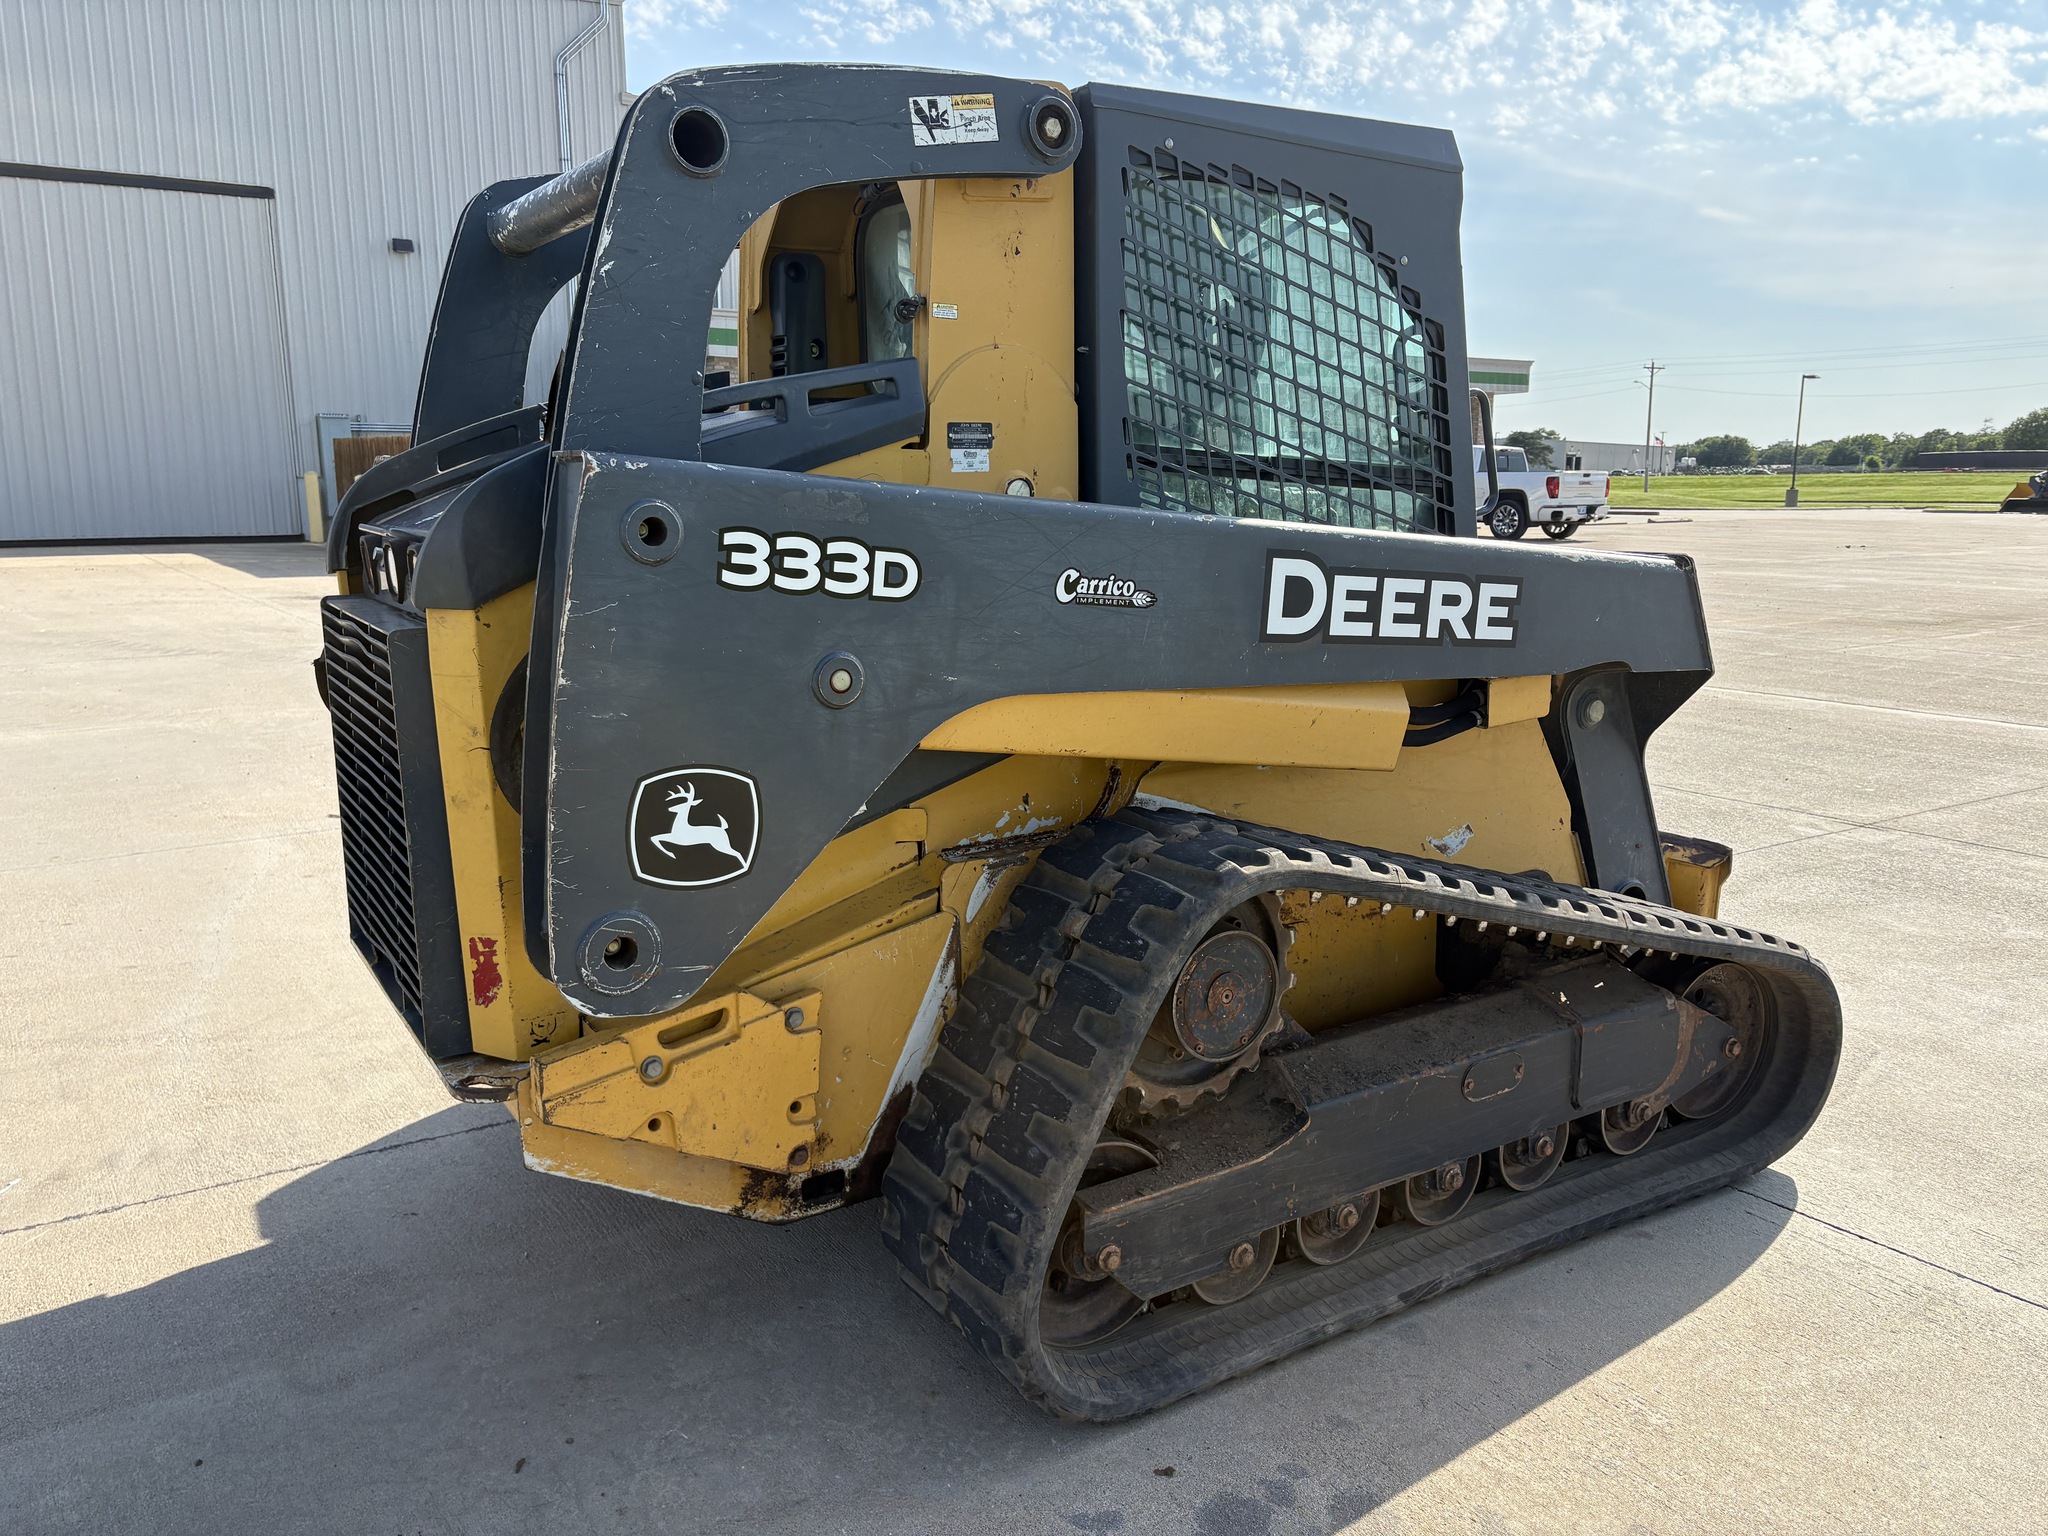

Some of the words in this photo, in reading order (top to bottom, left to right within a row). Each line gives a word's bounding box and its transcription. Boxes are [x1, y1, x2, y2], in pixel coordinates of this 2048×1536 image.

[960, 97, 992, 106] WARNING
[719, 531, 919, 598] 333D
[1055, 568, 1136, 603] Carrico
[1076, 597, 1131, 606] IMPLEMENT
[1266, 557, 1519, 641] DEERE
